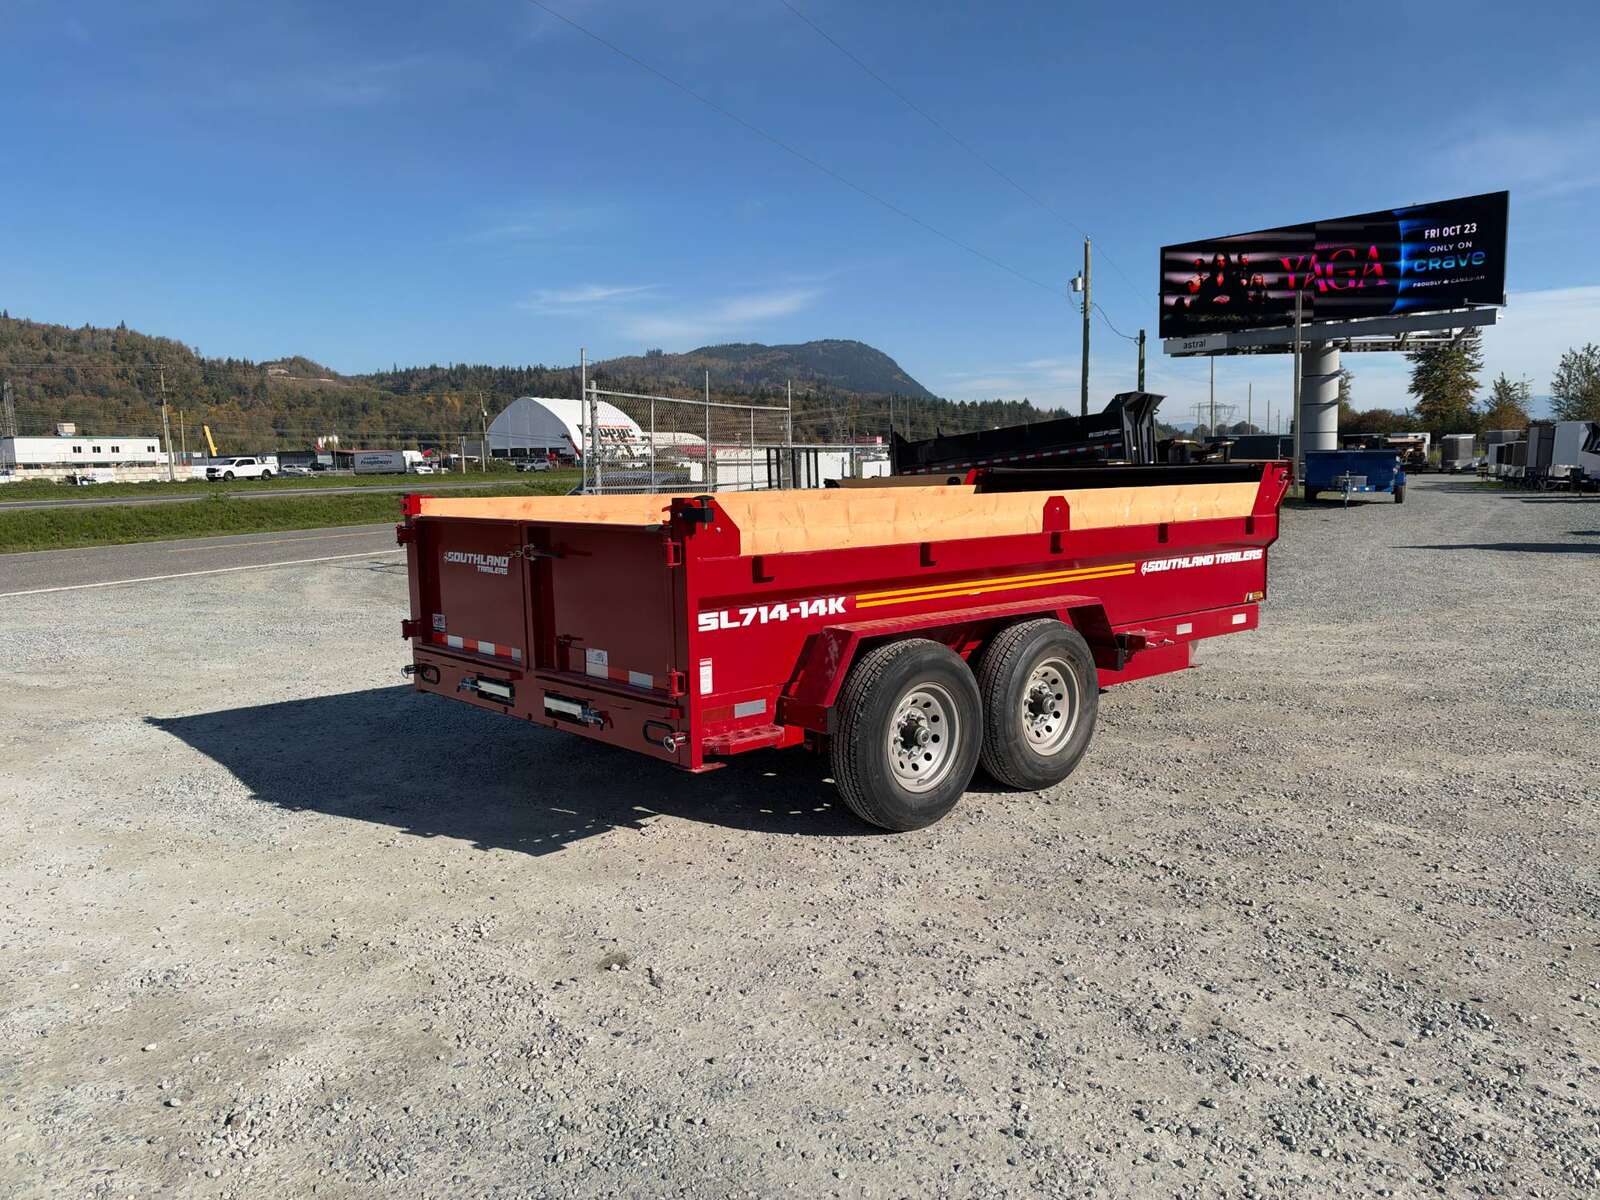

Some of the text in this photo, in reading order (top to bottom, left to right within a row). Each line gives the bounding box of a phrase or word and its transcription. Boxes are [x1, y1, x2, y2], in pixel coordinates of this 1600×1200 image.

[1424, 222, 1477, 239] FRI OCT 23
[1429, 241, 1473, 253] ONLY ON
[1281, 245, 1389, 292] YAGA
[1413, 280, 1441, 288] PROUDLY
[1183, 338, 1206, 350] astral
[447, 551, 509, 566] SOUTHLAND
[1147, 549, 1263, 573] SOUTHLAND TRAILERS
[477, 565, 508, 575] TRAILERS
[698, 596, 847, 632] SL714-14K
